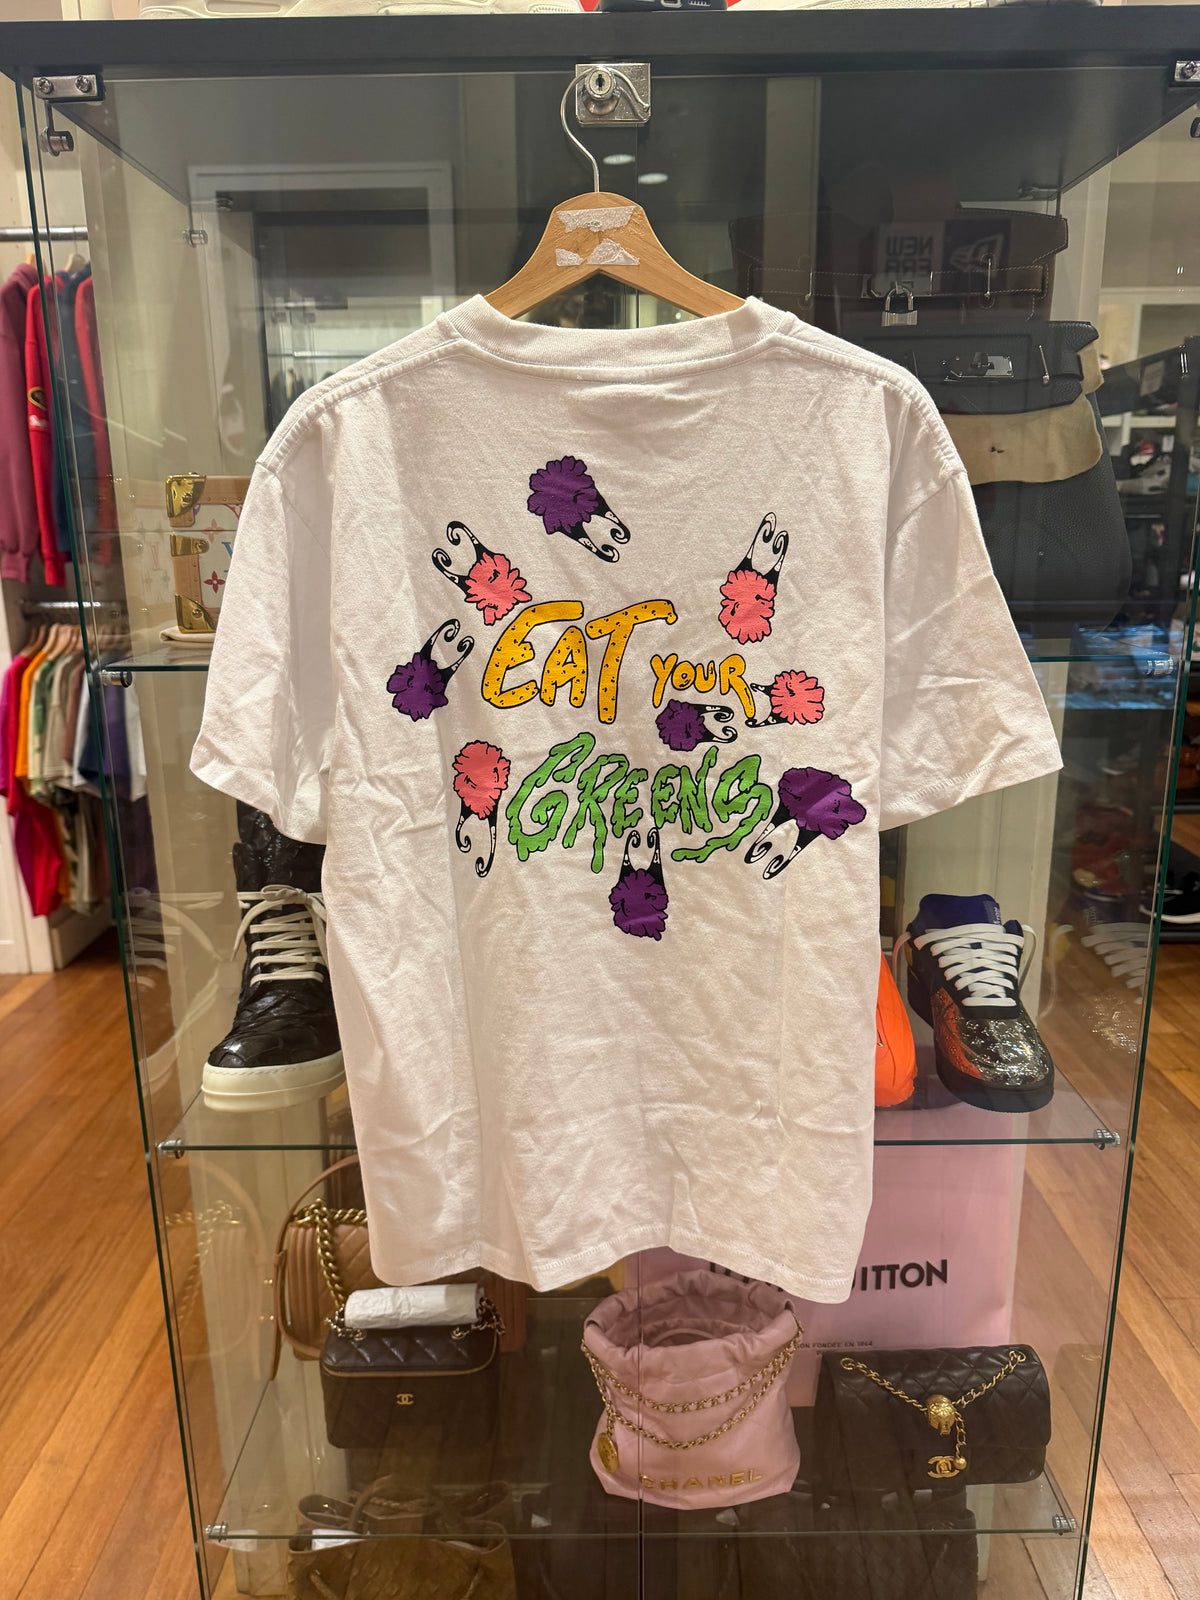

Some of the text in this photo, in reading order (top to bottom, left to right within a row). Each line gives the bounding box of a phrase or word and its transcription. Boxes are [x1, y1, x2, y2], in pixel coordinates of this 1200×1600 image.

[481, 599, 755, 724] EAT YOUR
[506, 732, 773, 873] GREENS
[852, 1259, 948, 1292] ITTON
[640, 1469, 762, 1490] CHANEL
